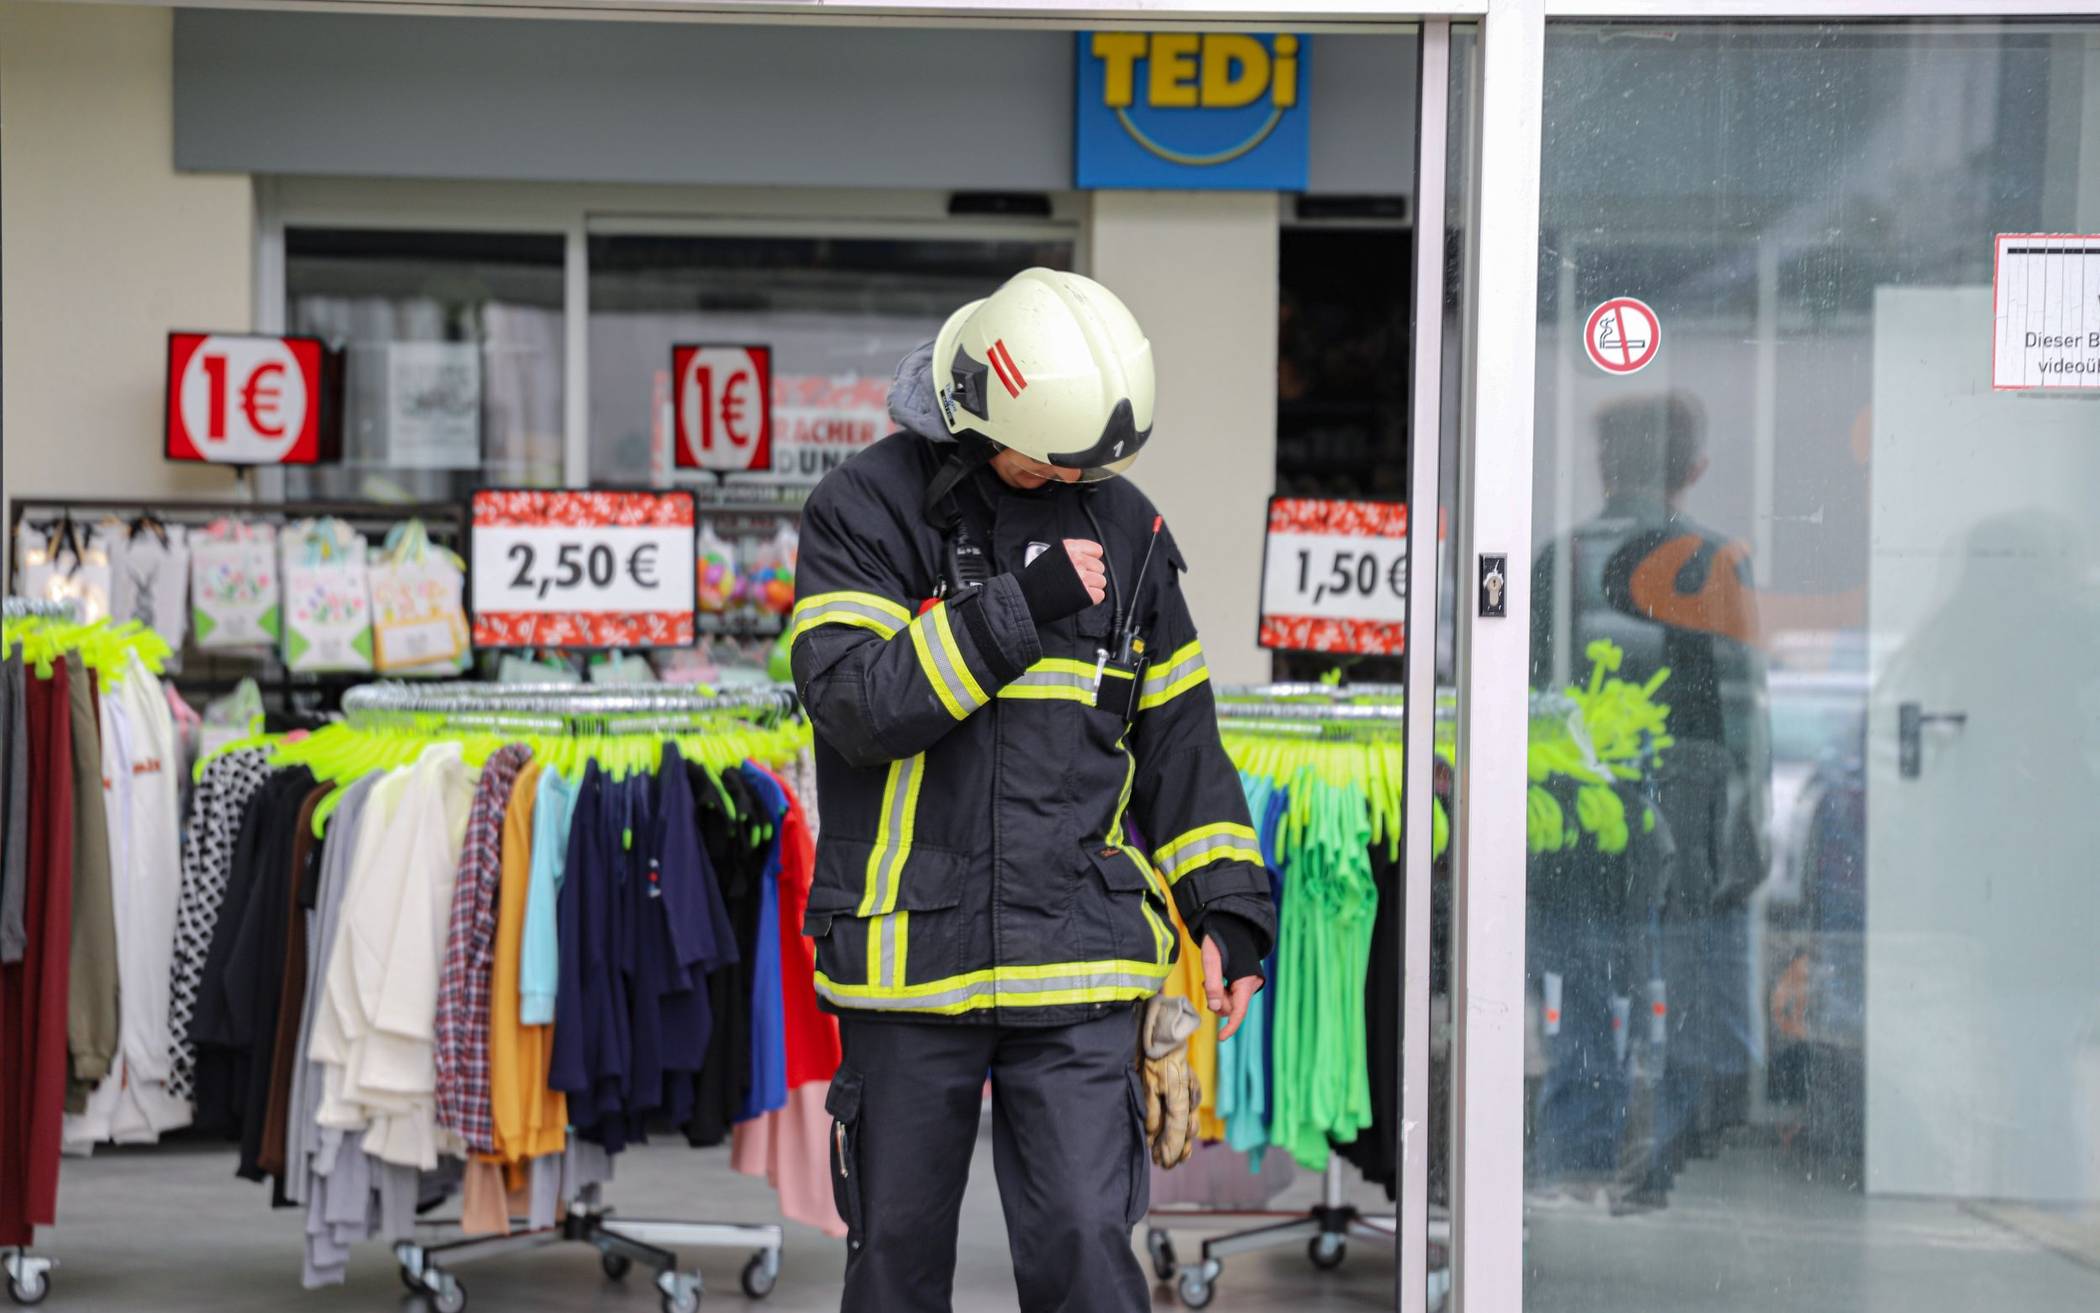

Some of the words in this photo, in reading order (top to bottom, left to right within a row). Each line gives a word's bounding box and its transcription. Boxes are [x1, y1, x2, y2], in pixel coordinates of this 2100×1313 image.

[1092, 31, 1298, 108] TEDi
[2025, 332, 2083, 348] Dieser
[2038, 358, 2100, 374] videoü
[203, 356, 286, 439] 1€
[696, 366, 748, 449] 1€
[507, 543, 616, 600] 2,50
[625, 543, 660, 589] €
[1297, 550, 1379, 605] 1,50
